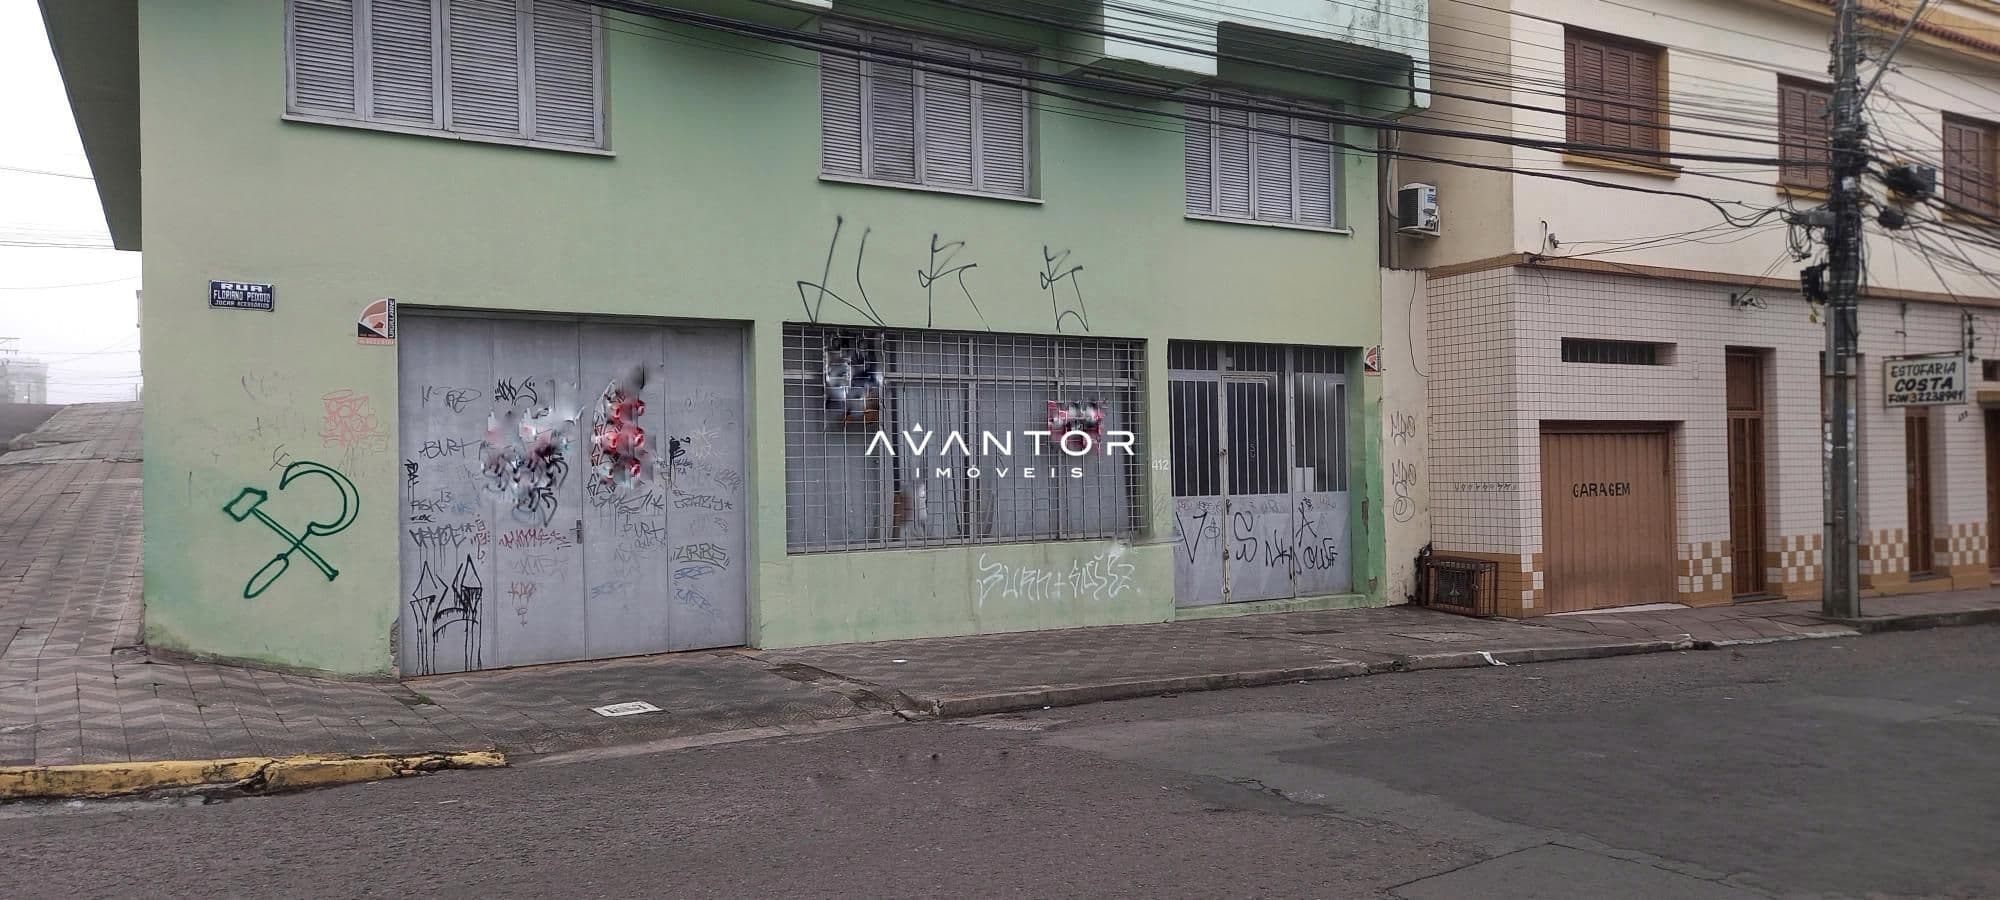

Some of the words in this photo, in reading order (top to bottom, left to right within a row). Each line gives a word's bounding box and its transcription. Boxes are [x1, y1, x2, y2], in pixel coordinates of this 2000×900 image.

[220, 283, 262, 292] RUA
[213, 289, 243, 300] FLORIANO
[246, 291, 270, 302] PEIXOTO
[1891, 362, 1956, 377] ESTOFARIA
[1894, 377, 1953, 392] COSTA
[1152, 459, 1169, 471] 412
[1572, 482, 1631, 497] GARAGEM
